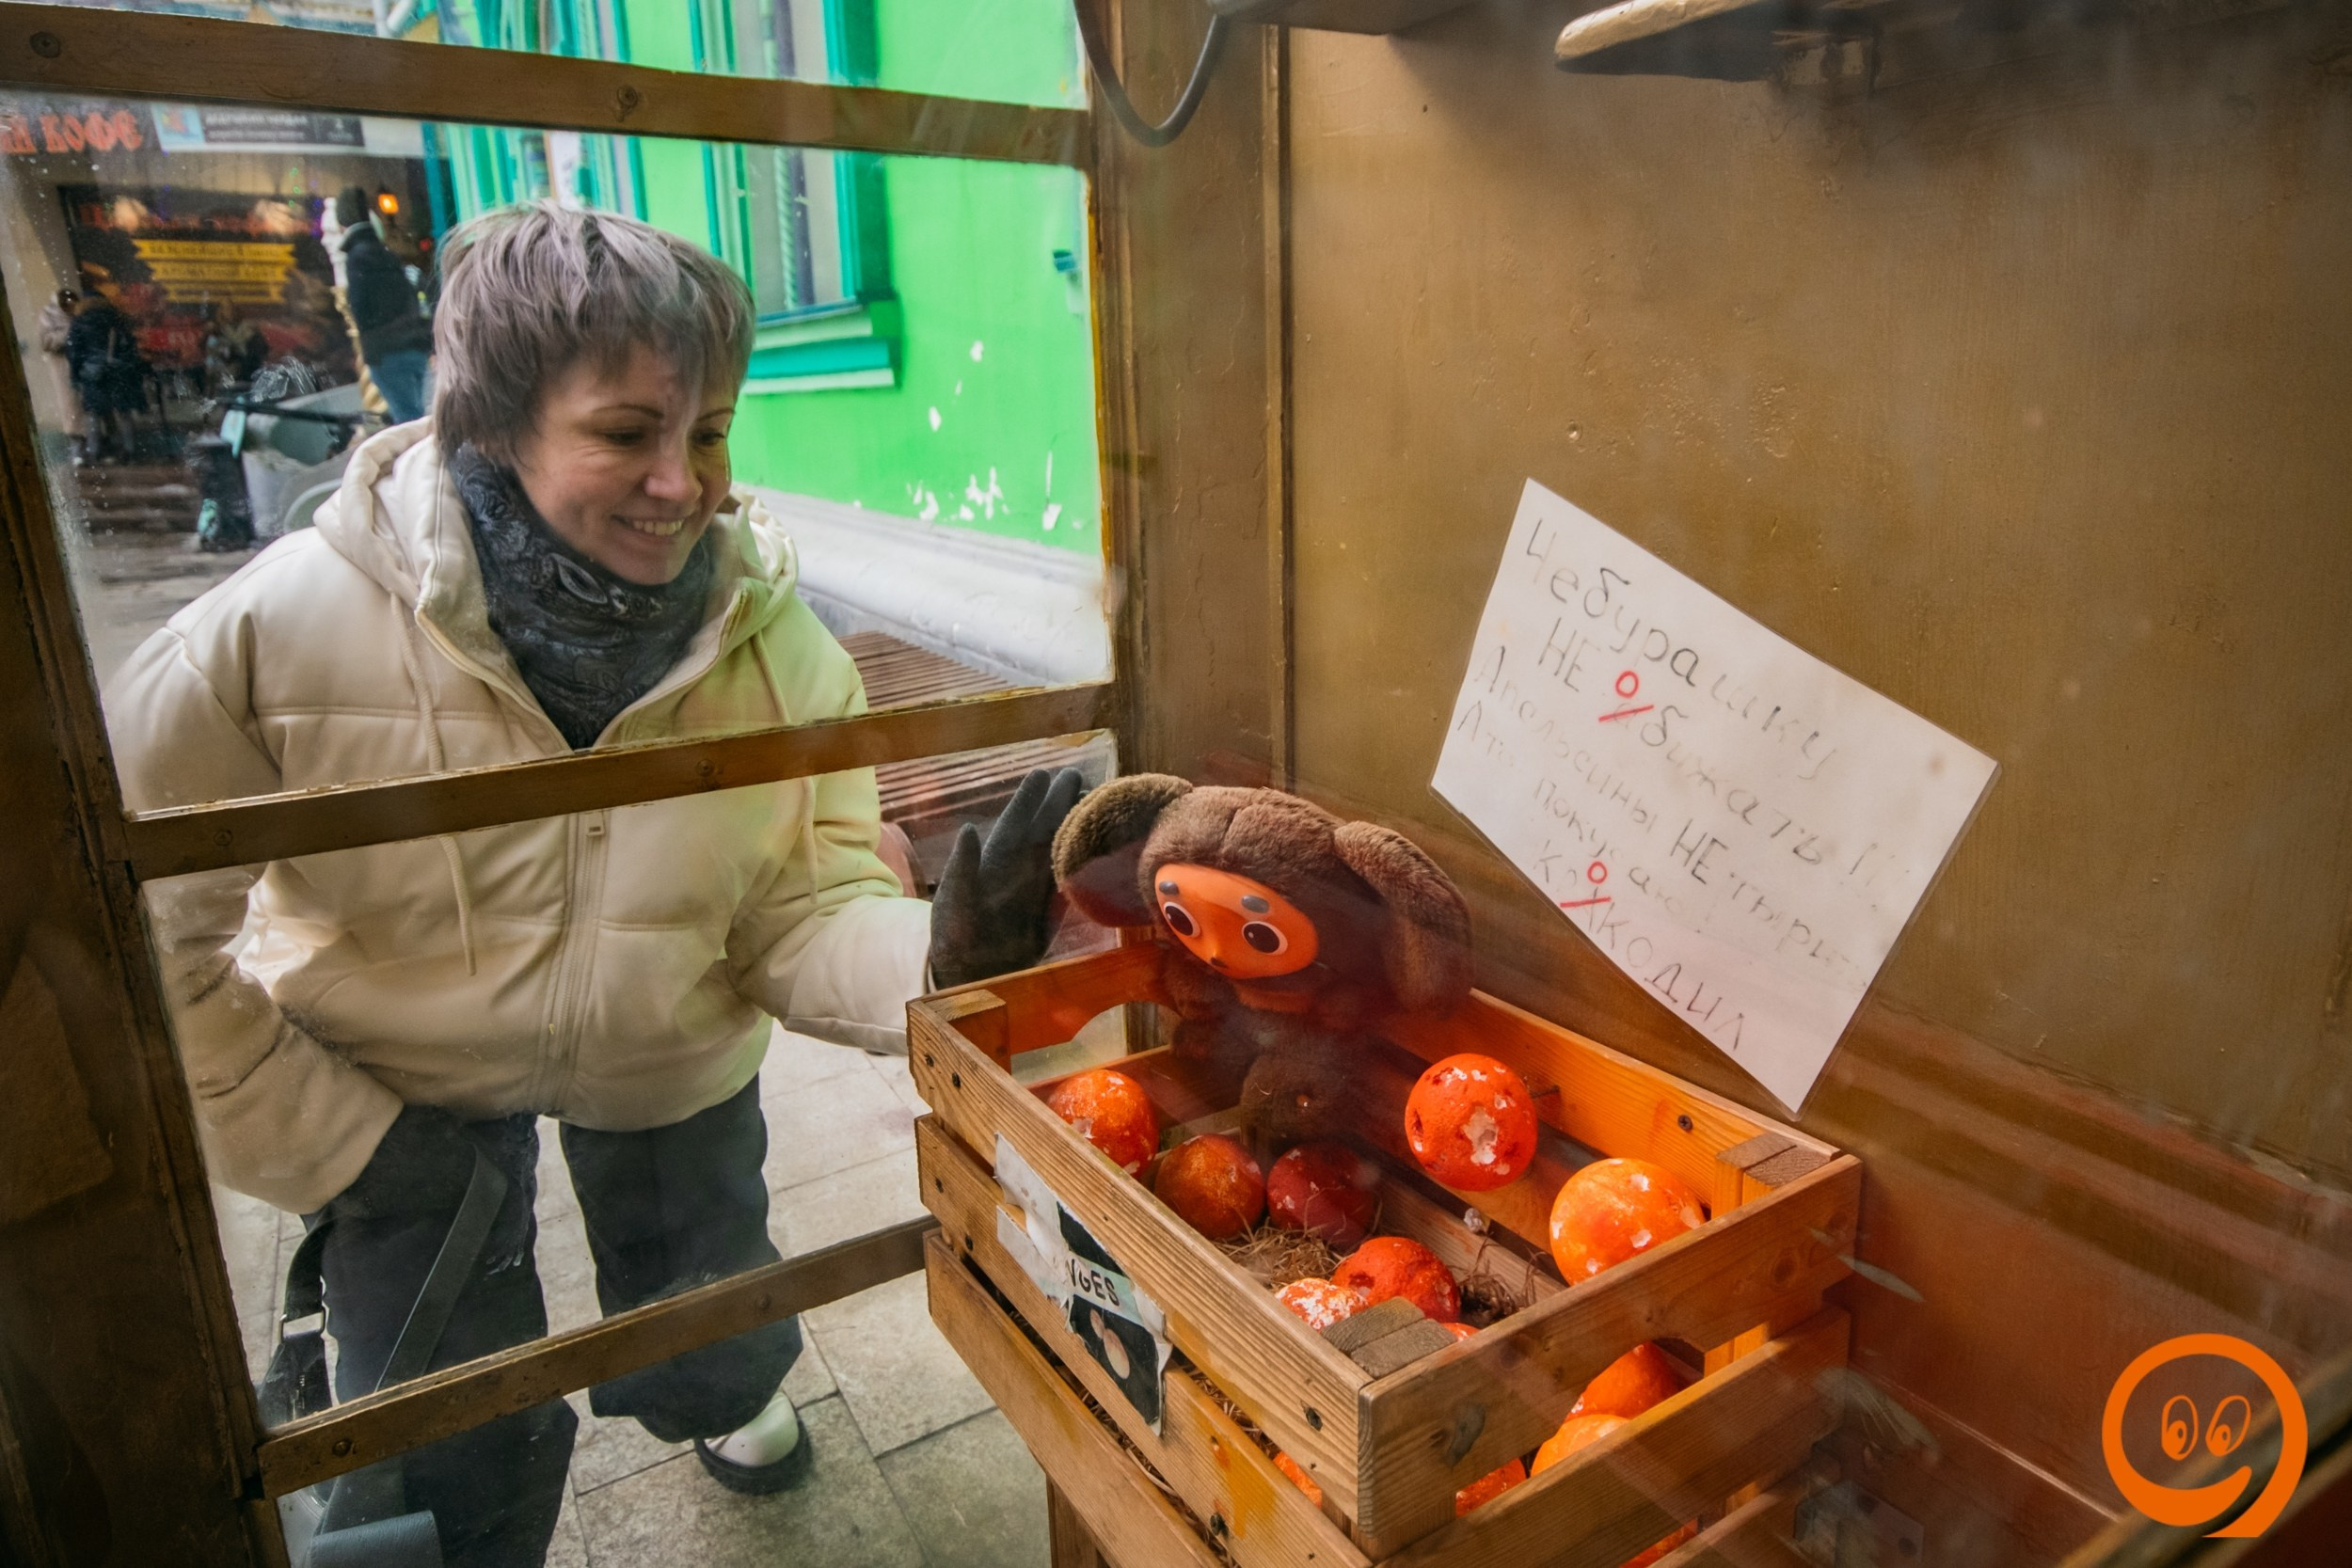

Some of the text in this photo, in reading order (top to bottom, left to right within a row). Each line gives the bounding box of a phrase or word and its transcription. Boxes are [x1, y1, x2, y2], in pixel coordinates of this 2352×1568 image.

[1526, 518, 1836, 780] Чебурашку
[1537, 617, 1601, 692] НЕ
[1670, 818, 1729, 885] НЕ
[1729, 871, 1868, 988] тыри
